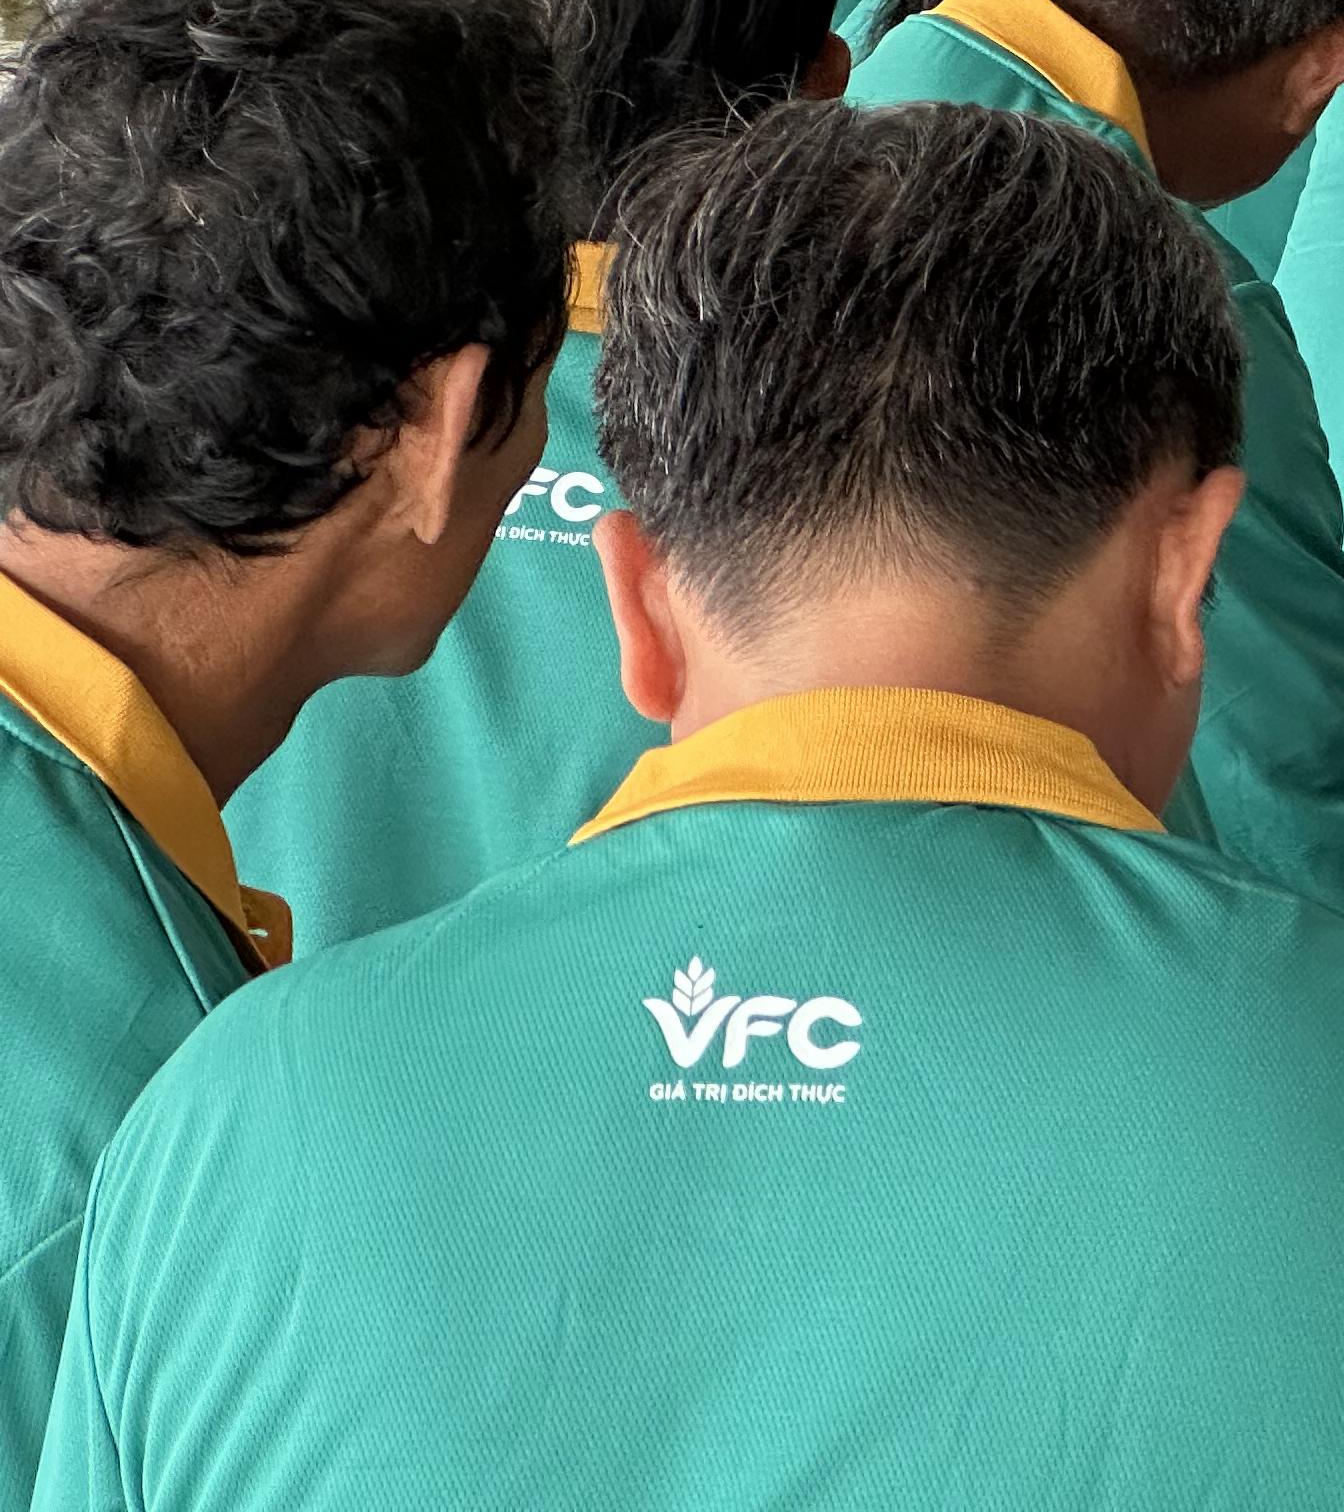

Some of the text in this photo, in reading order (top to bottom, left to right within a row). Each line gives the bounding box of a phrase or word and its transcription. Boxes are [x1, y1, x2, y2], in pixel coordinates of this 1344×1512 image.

[504, 466, 605, 523] FC
[509, 525, 545, 542] ĐÍCH
[549, 530, 591, 547] THỰC
[642, 994, 863, 1070] VFC
[649, 1079, 847, 1105] GIÁ TRỊ ĐÍCH THỰC
